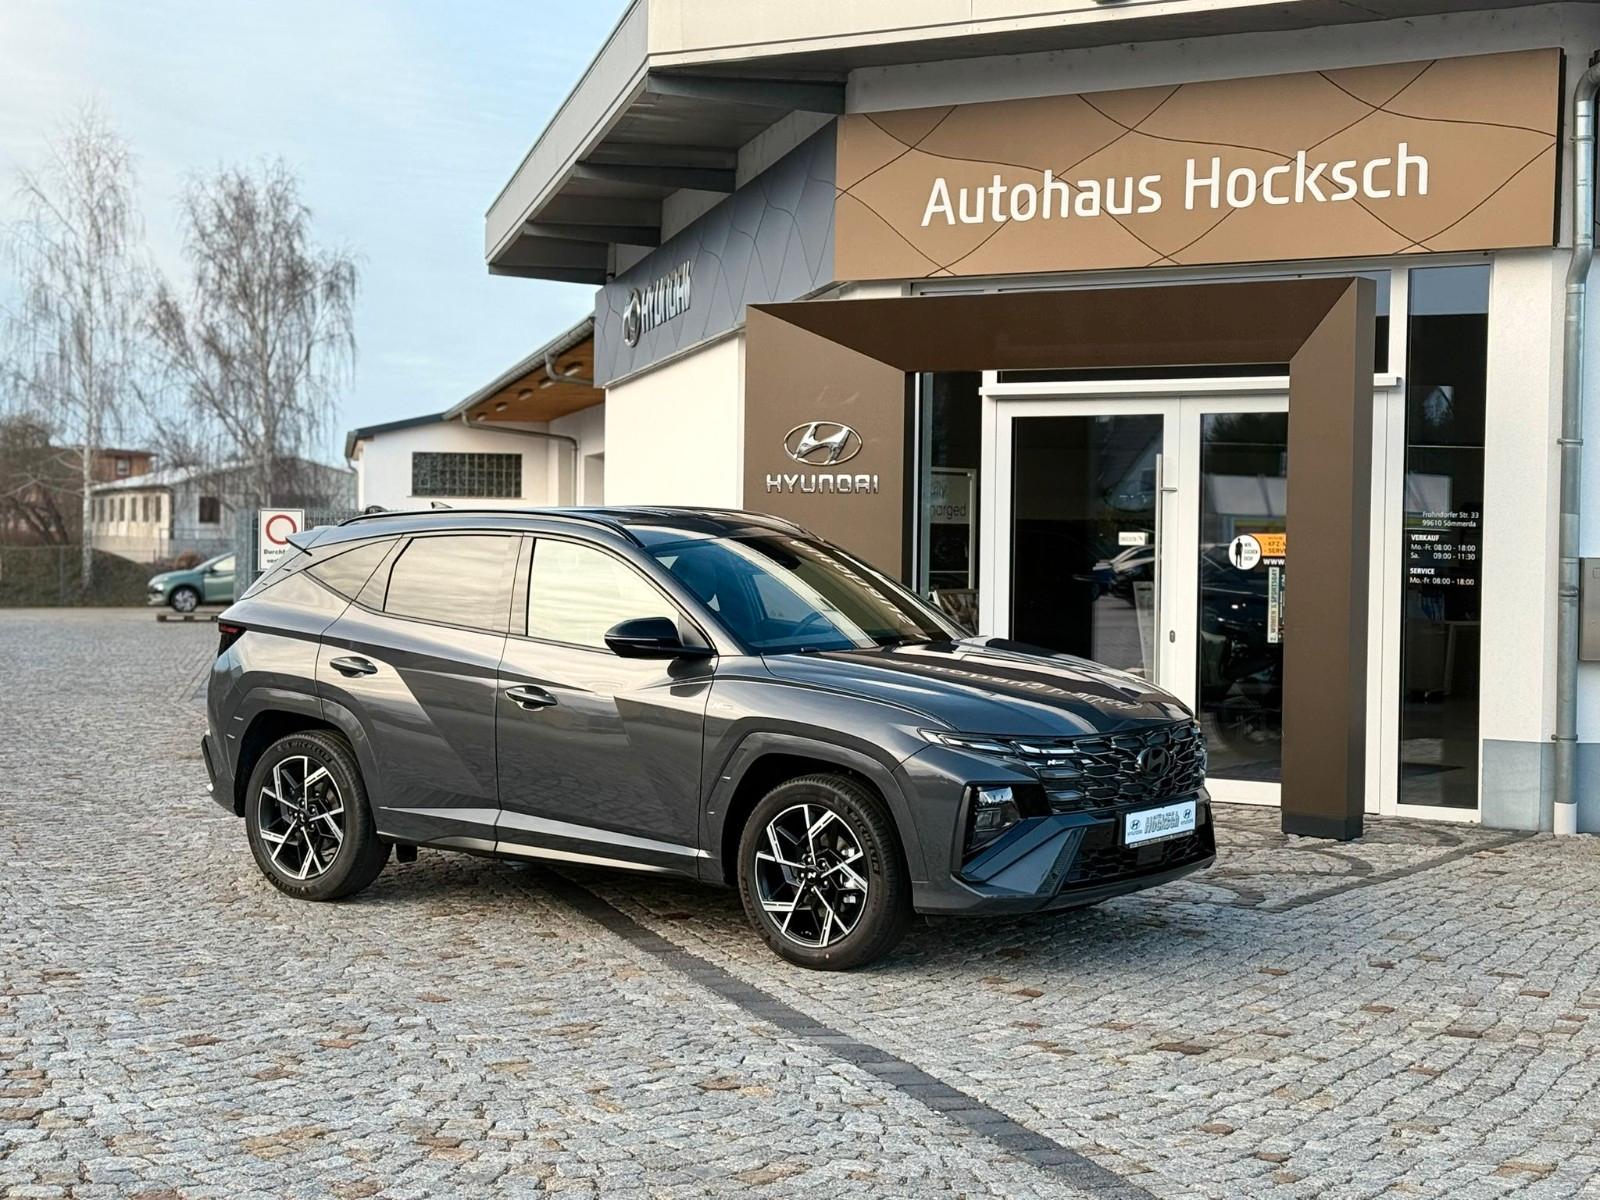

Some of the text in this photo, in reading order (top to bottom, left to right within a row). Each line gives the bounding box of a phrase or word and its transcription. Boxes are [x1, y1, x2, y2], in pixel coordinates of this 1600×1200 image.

[921, 142, 1429, 227] Autohaus Hocksch
[766, 473, 880, 494] HYUNDAI
[1459, 511, 1469, 519] Str.
